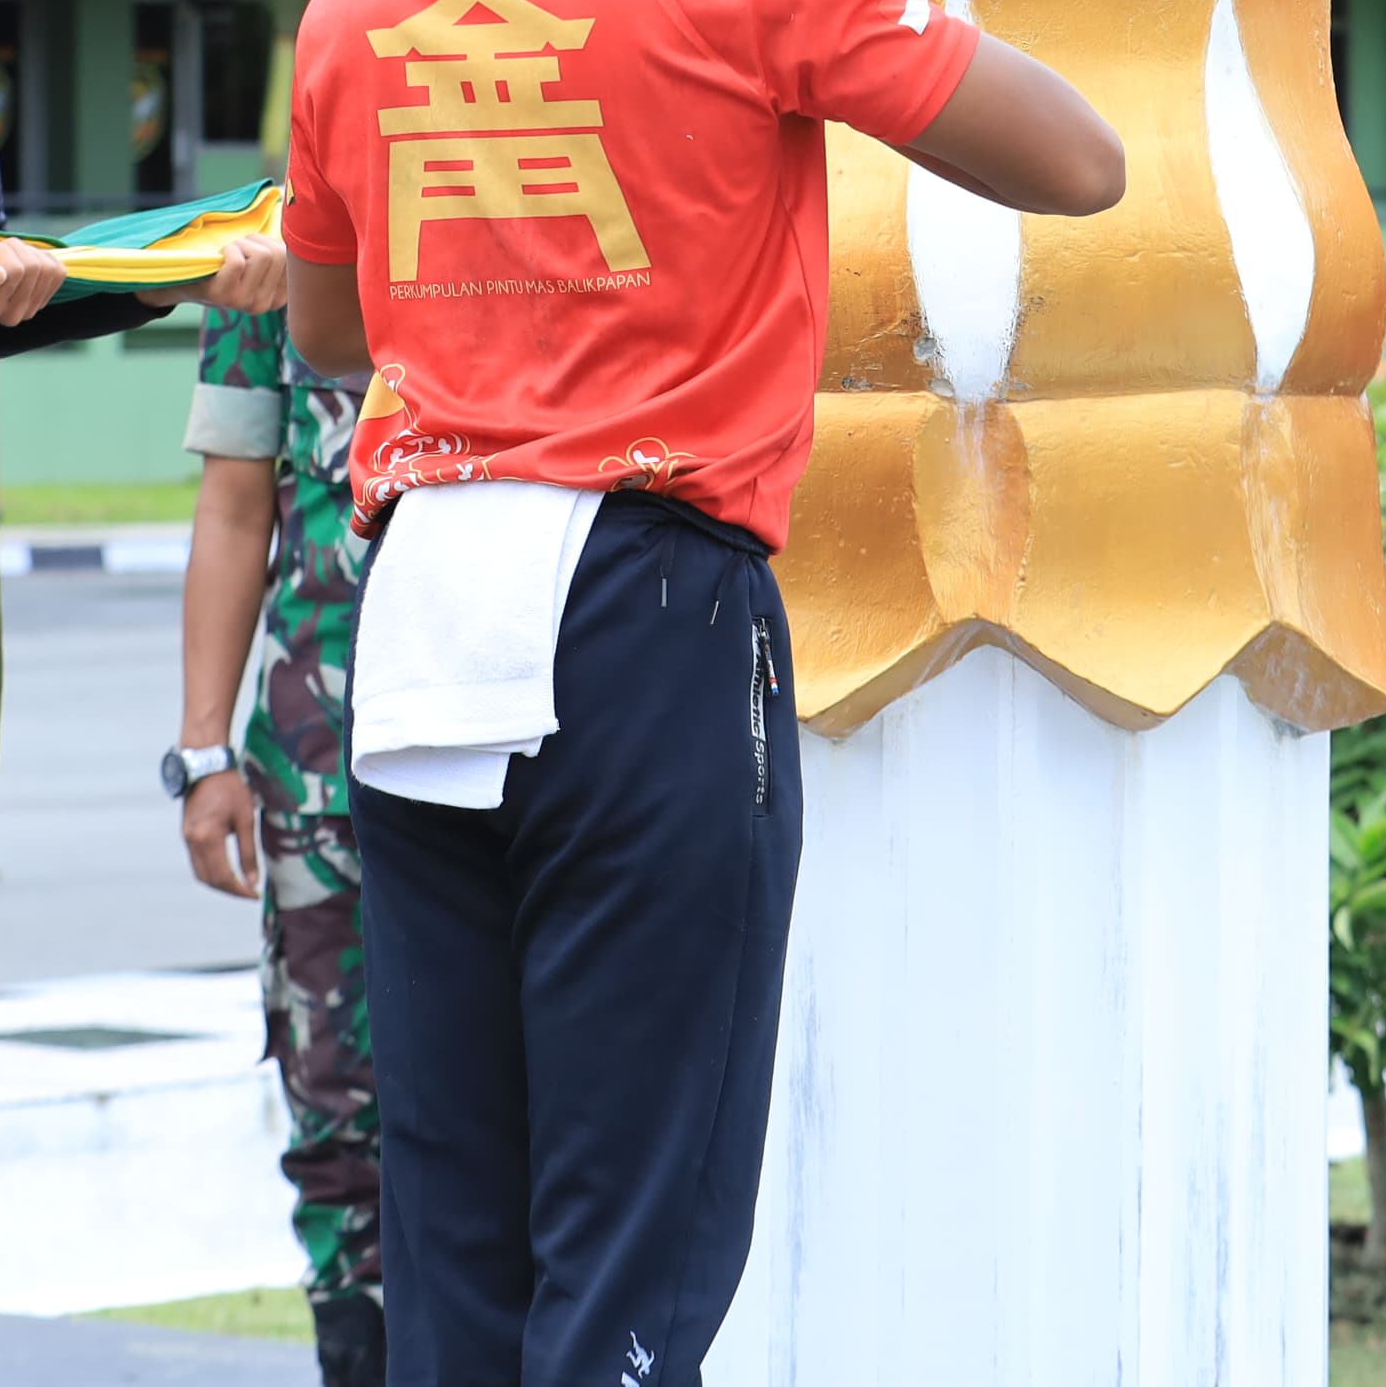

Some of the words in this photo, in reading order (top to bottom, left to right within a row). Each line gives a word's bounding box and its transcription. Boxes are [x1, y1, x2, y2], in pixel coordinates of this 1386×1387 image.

[389, 281, 483, 301] PERKUMPULAN
[486, 279, 524, 295] PINTU
[524, 279, 555, 295] MAS
[556, 271, 651, 295] BALIKPAPAN
[753, 740, 765, 804] Sports
